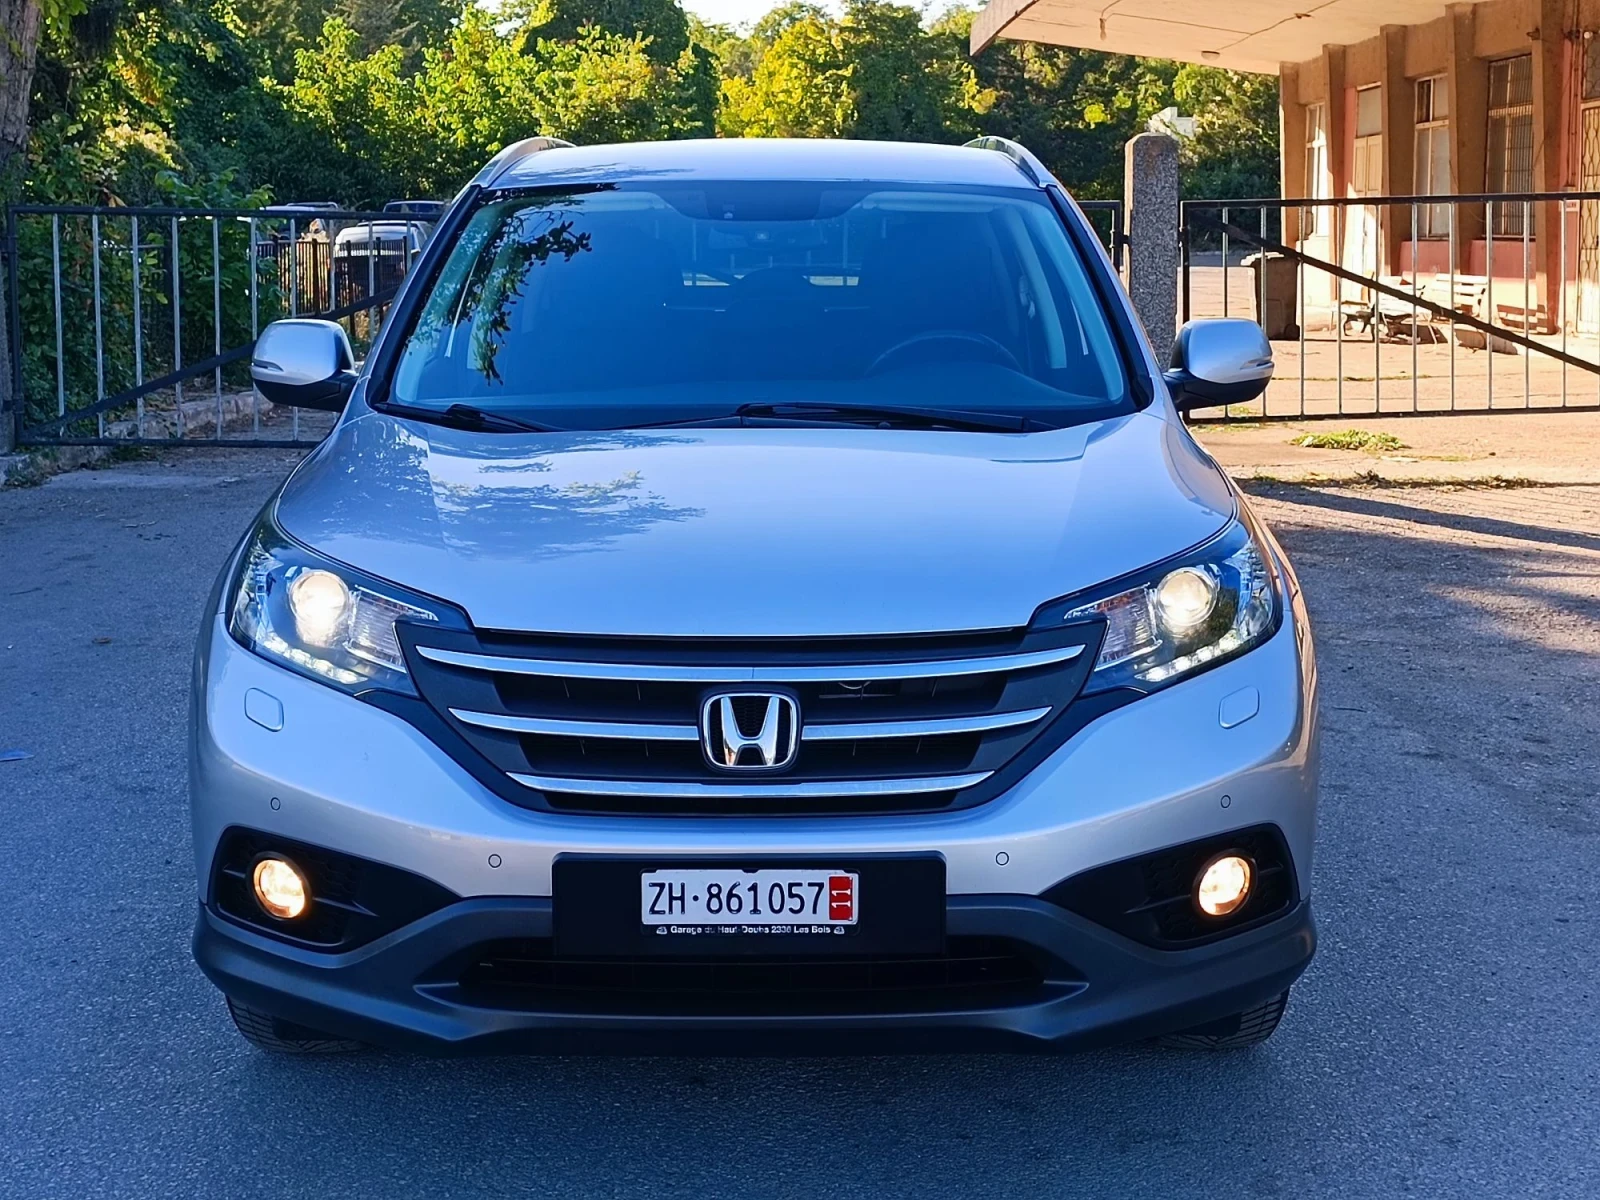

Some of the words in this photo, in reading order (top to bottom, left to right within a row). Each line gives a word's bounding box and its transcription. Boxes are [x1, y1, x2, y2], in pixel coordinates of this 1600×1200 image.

[831, 888, 851, 909] 11
[670, 925, 702, 935] Garage
[793, 925, 810, 934] Les
[811, 925, 832, 934] Bois
